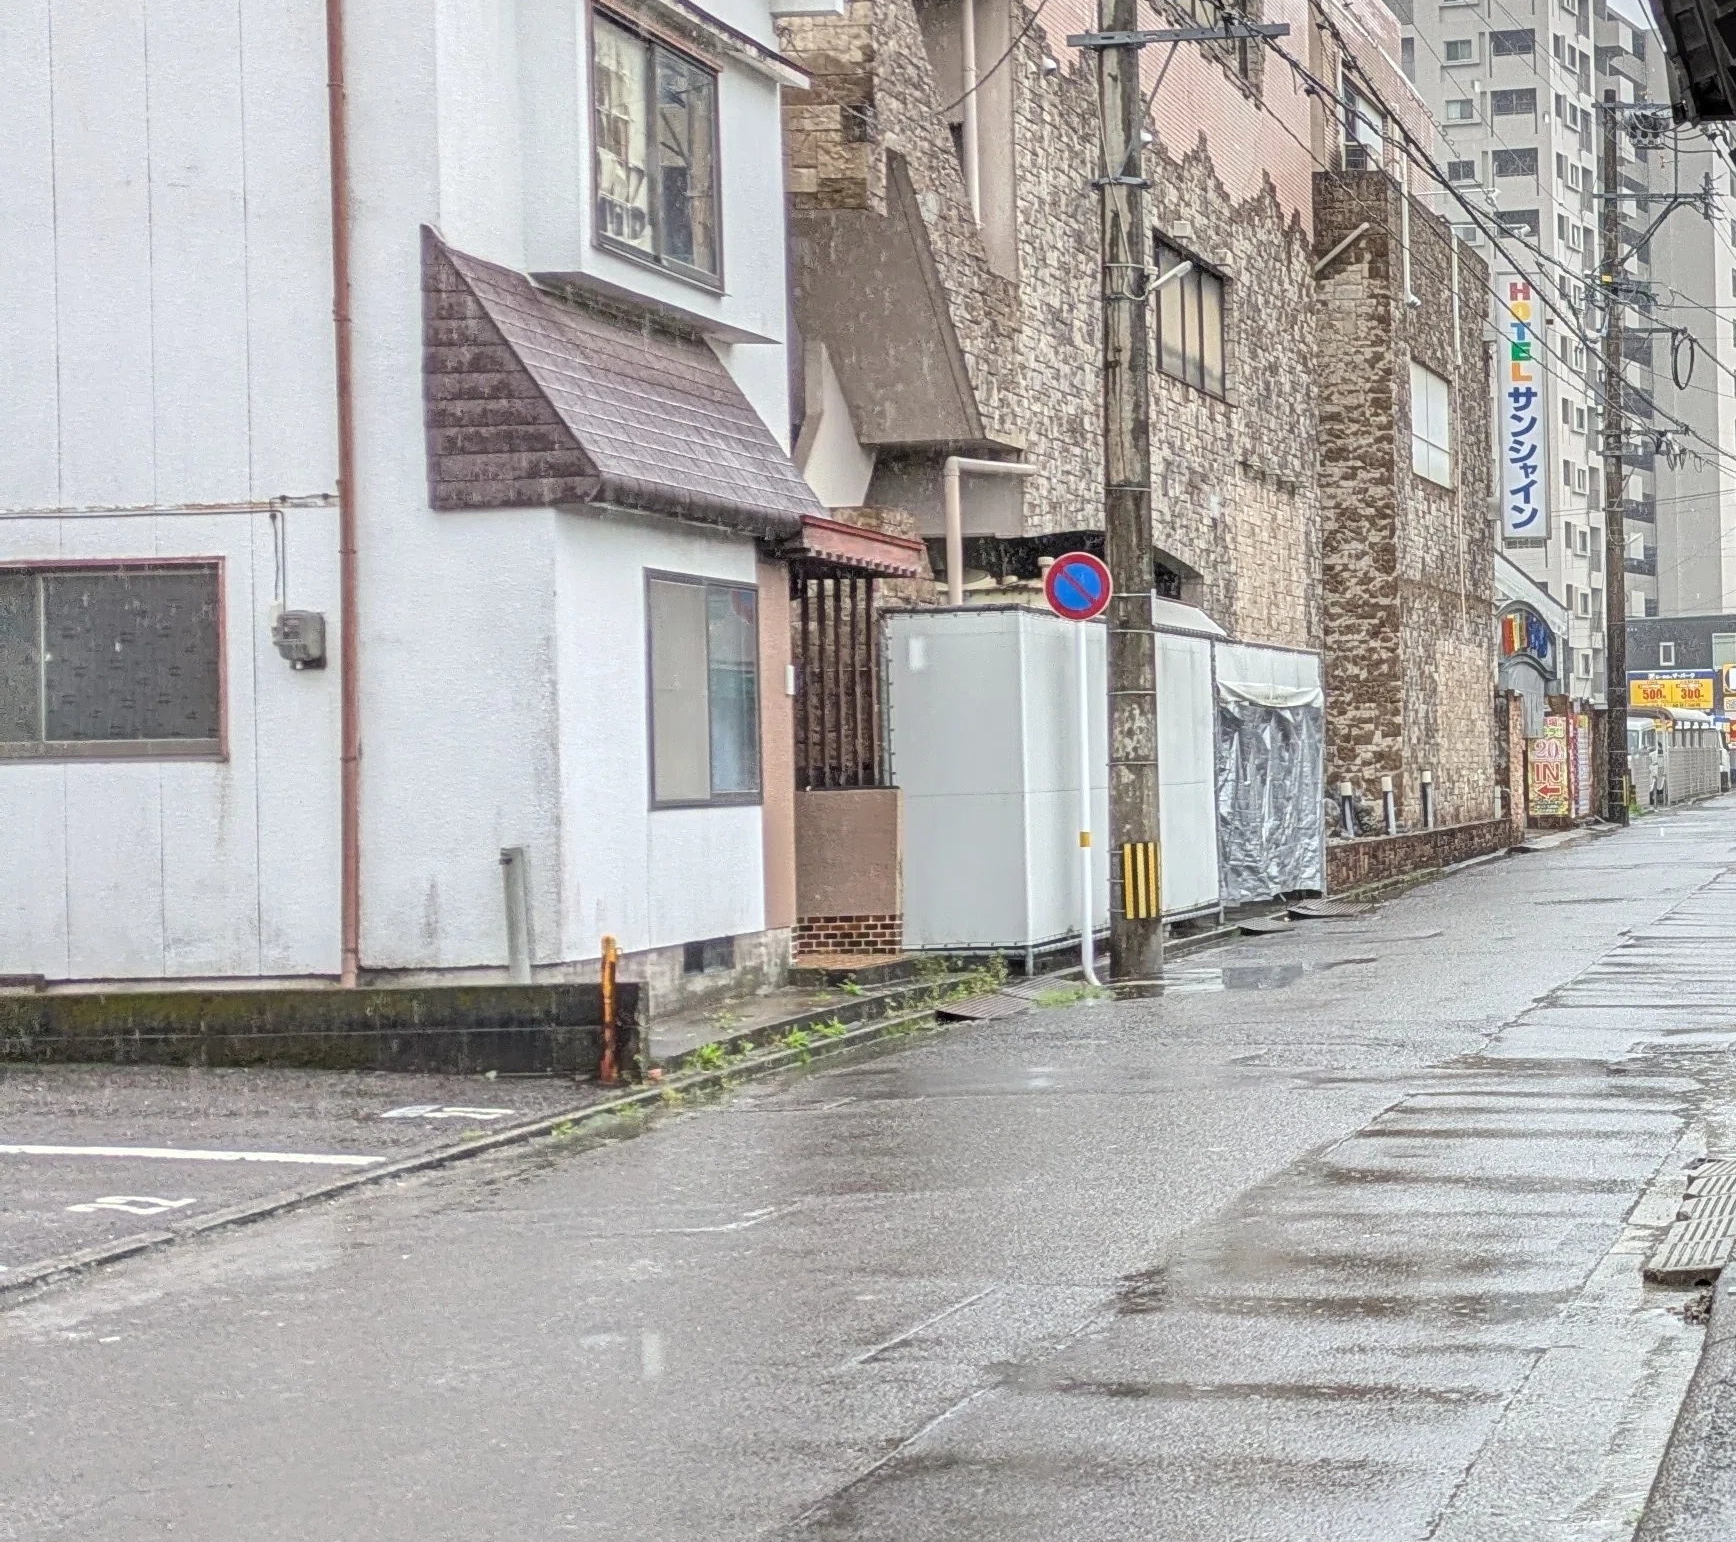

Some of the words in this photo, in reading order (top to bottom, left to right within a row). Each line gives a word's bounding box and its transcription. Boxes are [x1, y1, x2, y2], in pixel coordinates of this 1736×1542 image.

[1509, 282, 1533, 382] HOTEL
[1507, 386, 1538, 530] サンシャイン
[1535, 763, 1560, 782] IN
